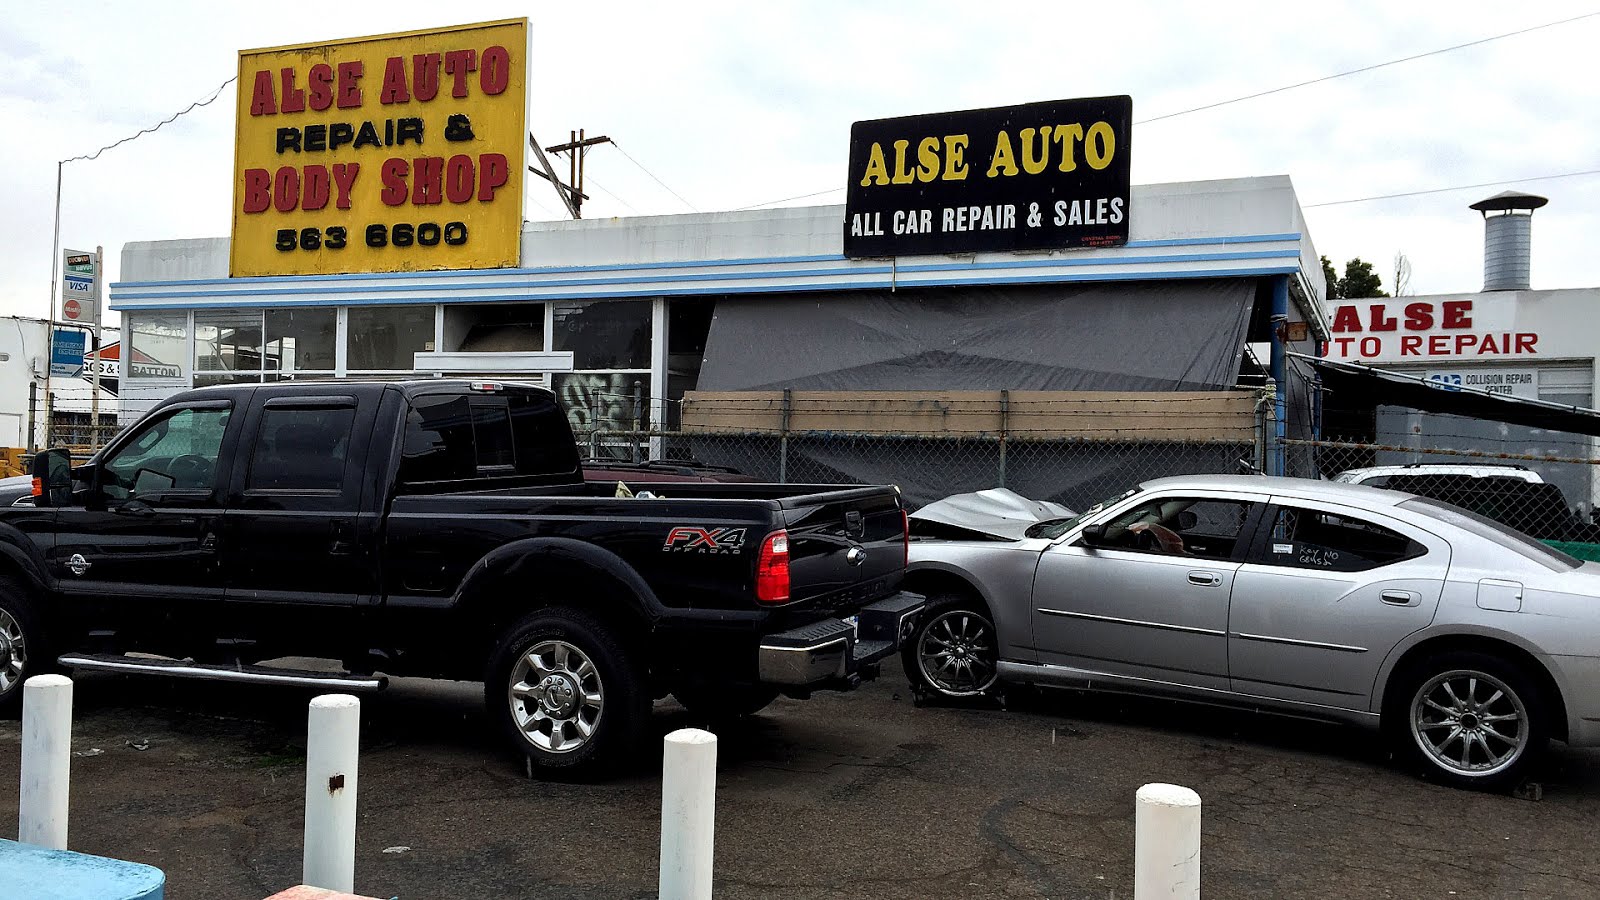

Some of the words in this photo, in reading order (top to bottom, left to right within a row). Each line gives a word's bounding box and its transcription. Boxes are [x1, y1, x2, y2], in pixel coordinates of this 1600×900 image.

[250, 60, 364, 116] ALSE
[380, 45, 510, 104] AUTO
[275, 117, 424, 154] REPAIR
[444, 113, 475, 142] &
[860, 133, 969, 187] ALSE
[986, 121, 1116, 177] AUTO
[243, 162, 360, 214] BODY
[380, 153, 508, 206] SHOP
[851, 212, 884, 237] ALL
[893, 209, 932, 235] CAR
[942, 204, 1016, 232] REPAIR
[1026, 201, 1043, 227] &
[1053, 197, 1124, 226] SALES
[275, 226, 347, 252] 563
[365, 221, 468, 248] 6600
[69, 282, 88, 291] VISA
[1332, 300, 1473, 332] ALSE
[1321, 336, 1382, 357] TO
[1400, 333, 1539, 356] REPAIR
[106, 363, 114, 374] &
[1465, 374, 1503, 385] COLLISION
[1505, 374, 1532, 384] REPAIR
[1485, 385, 1513, 395] CENTER
[664, 526, 748, 549] FX4
